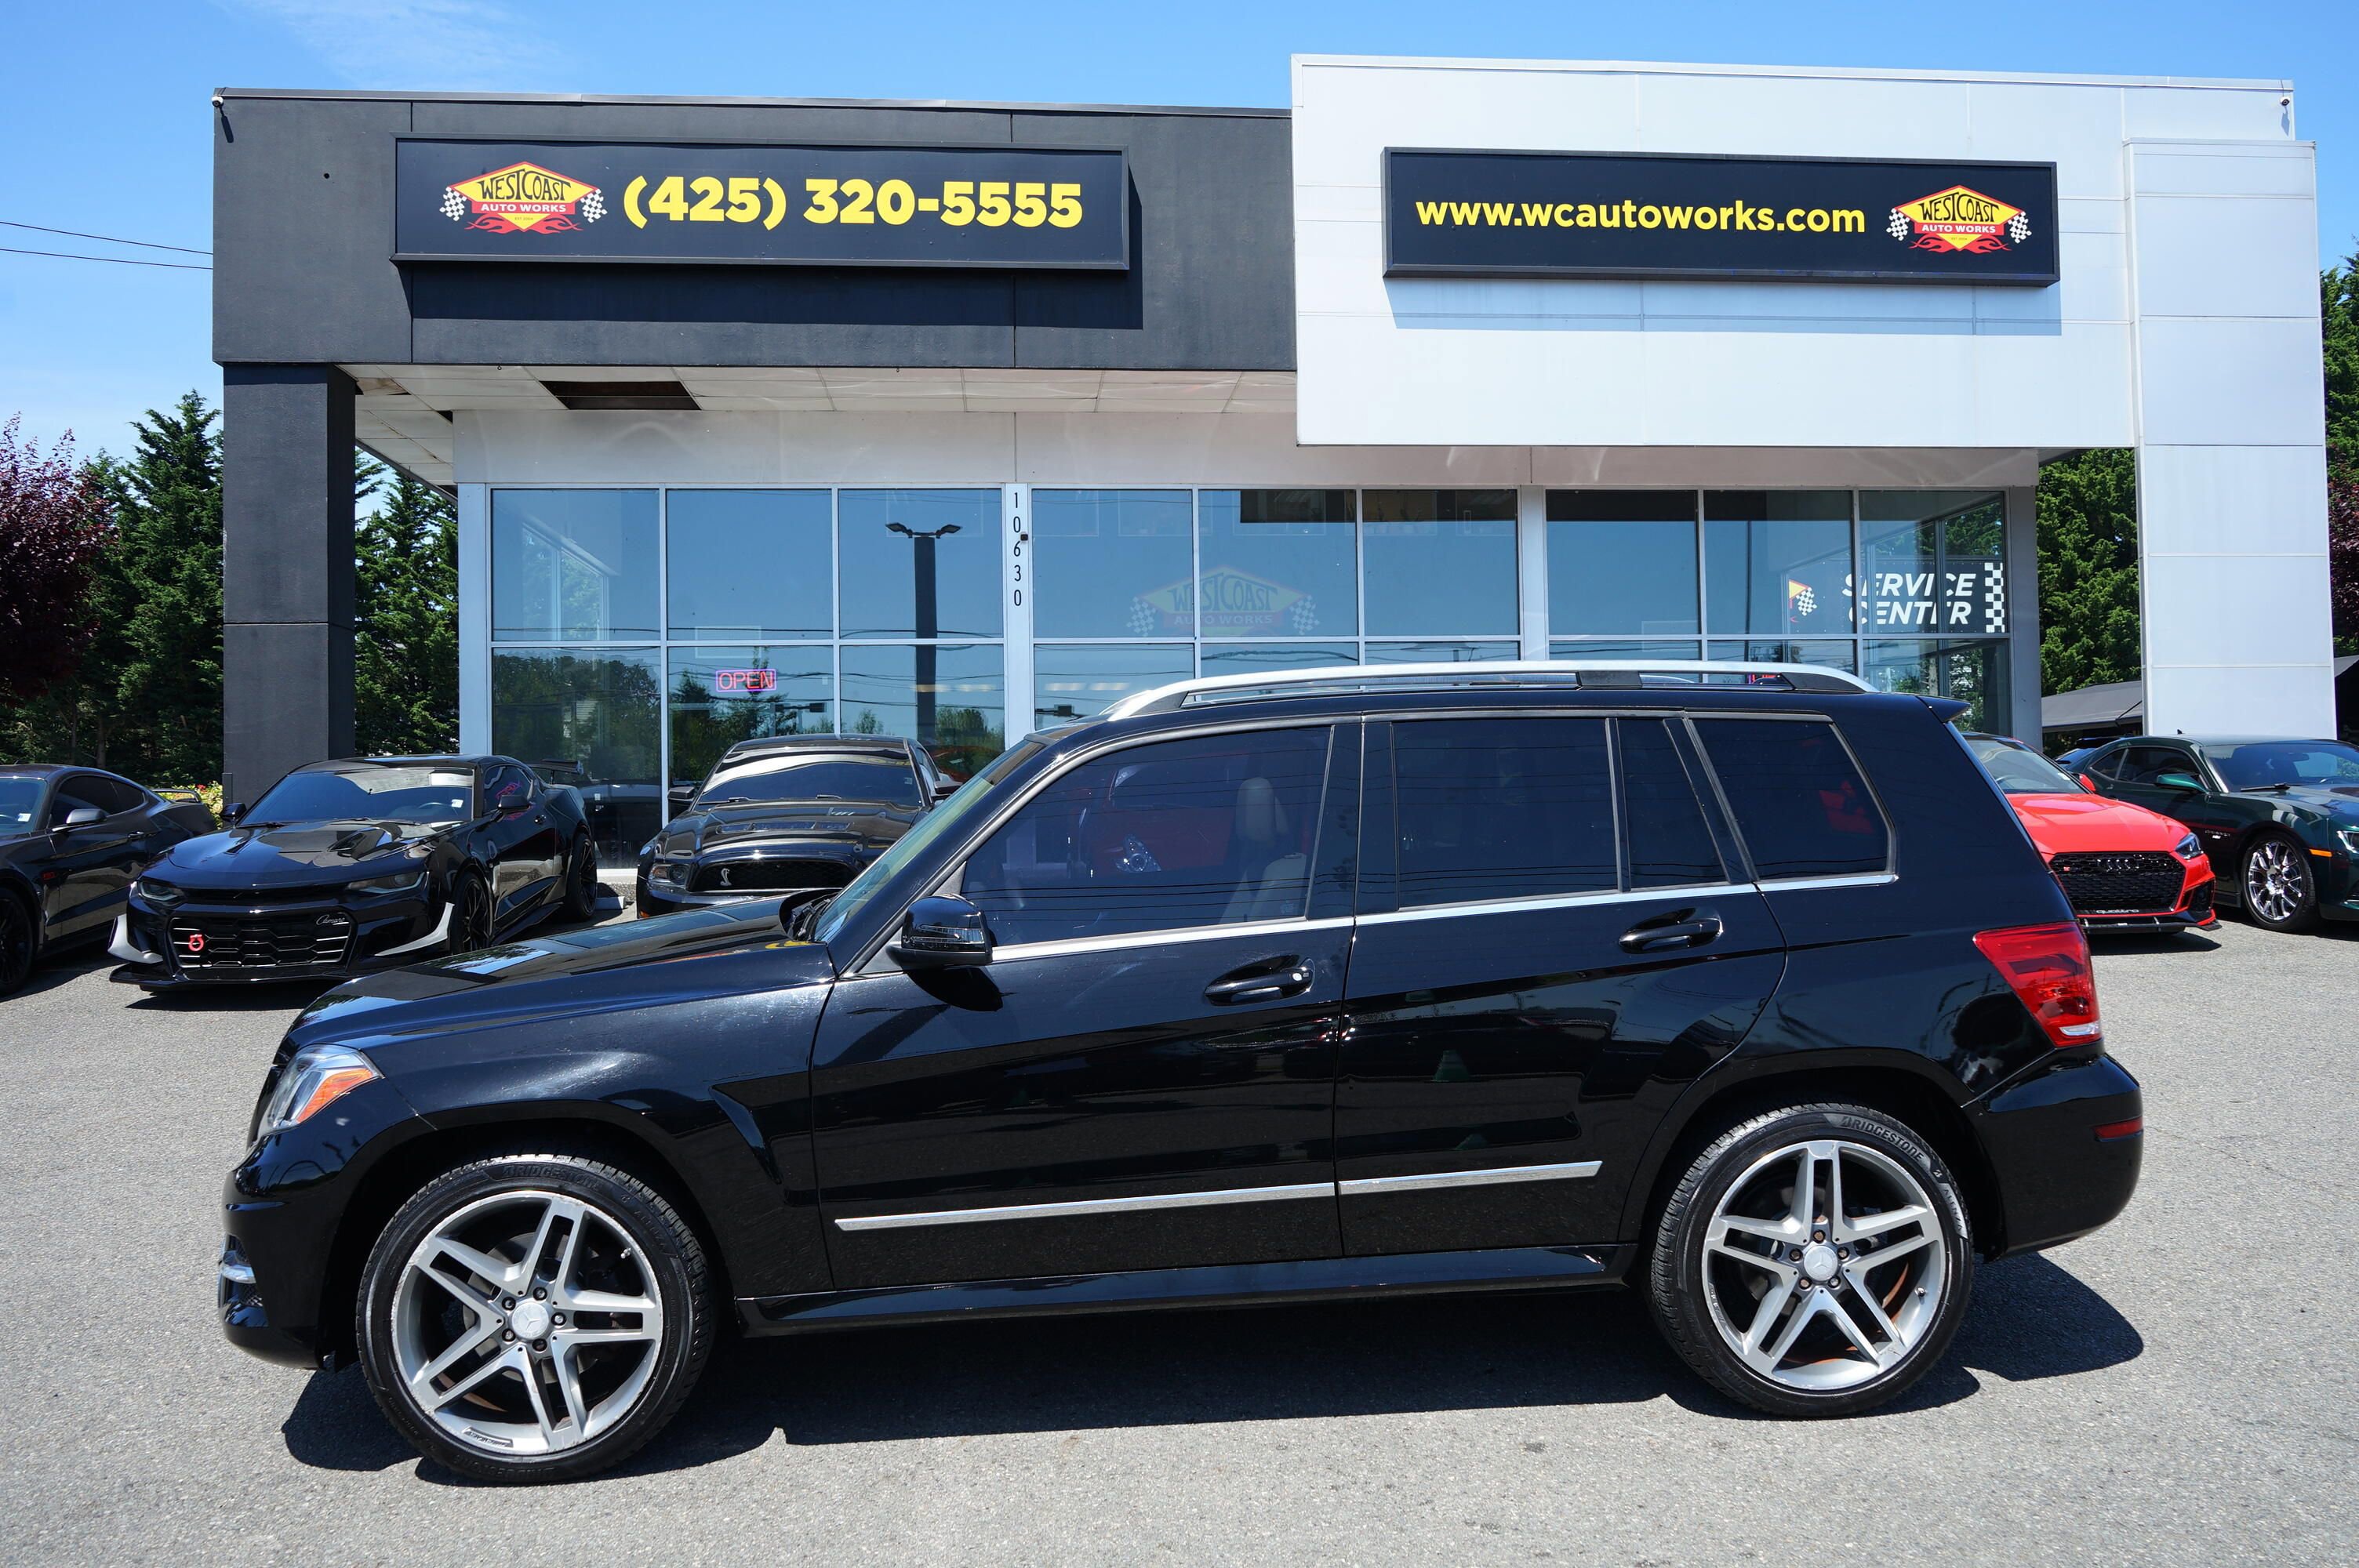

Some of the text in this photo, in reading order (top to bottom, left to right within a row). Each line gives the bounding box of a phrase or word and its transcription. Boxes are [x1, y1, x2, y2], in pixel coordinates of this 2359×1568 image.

[477, 169, 572, 201] WESTCOAST
[519, 204, 567, 212] WORKS
[623, 175, 1083, 231] (425) 320-5555
[1416, 199, 1865, 233] www.wcautoworks.com
[1918, 191, 2000, 223] WESTCOAST
[1955, 225, 1996, 234] WORKS
[1167, 572, 1278, 612] WSTCOAST
[1174, 615, 1273, 626] AUO WORKS
[718, 671, 773, 690] OPEN
[1841, 1116, 1925, 1163] BRIDGESTONE
